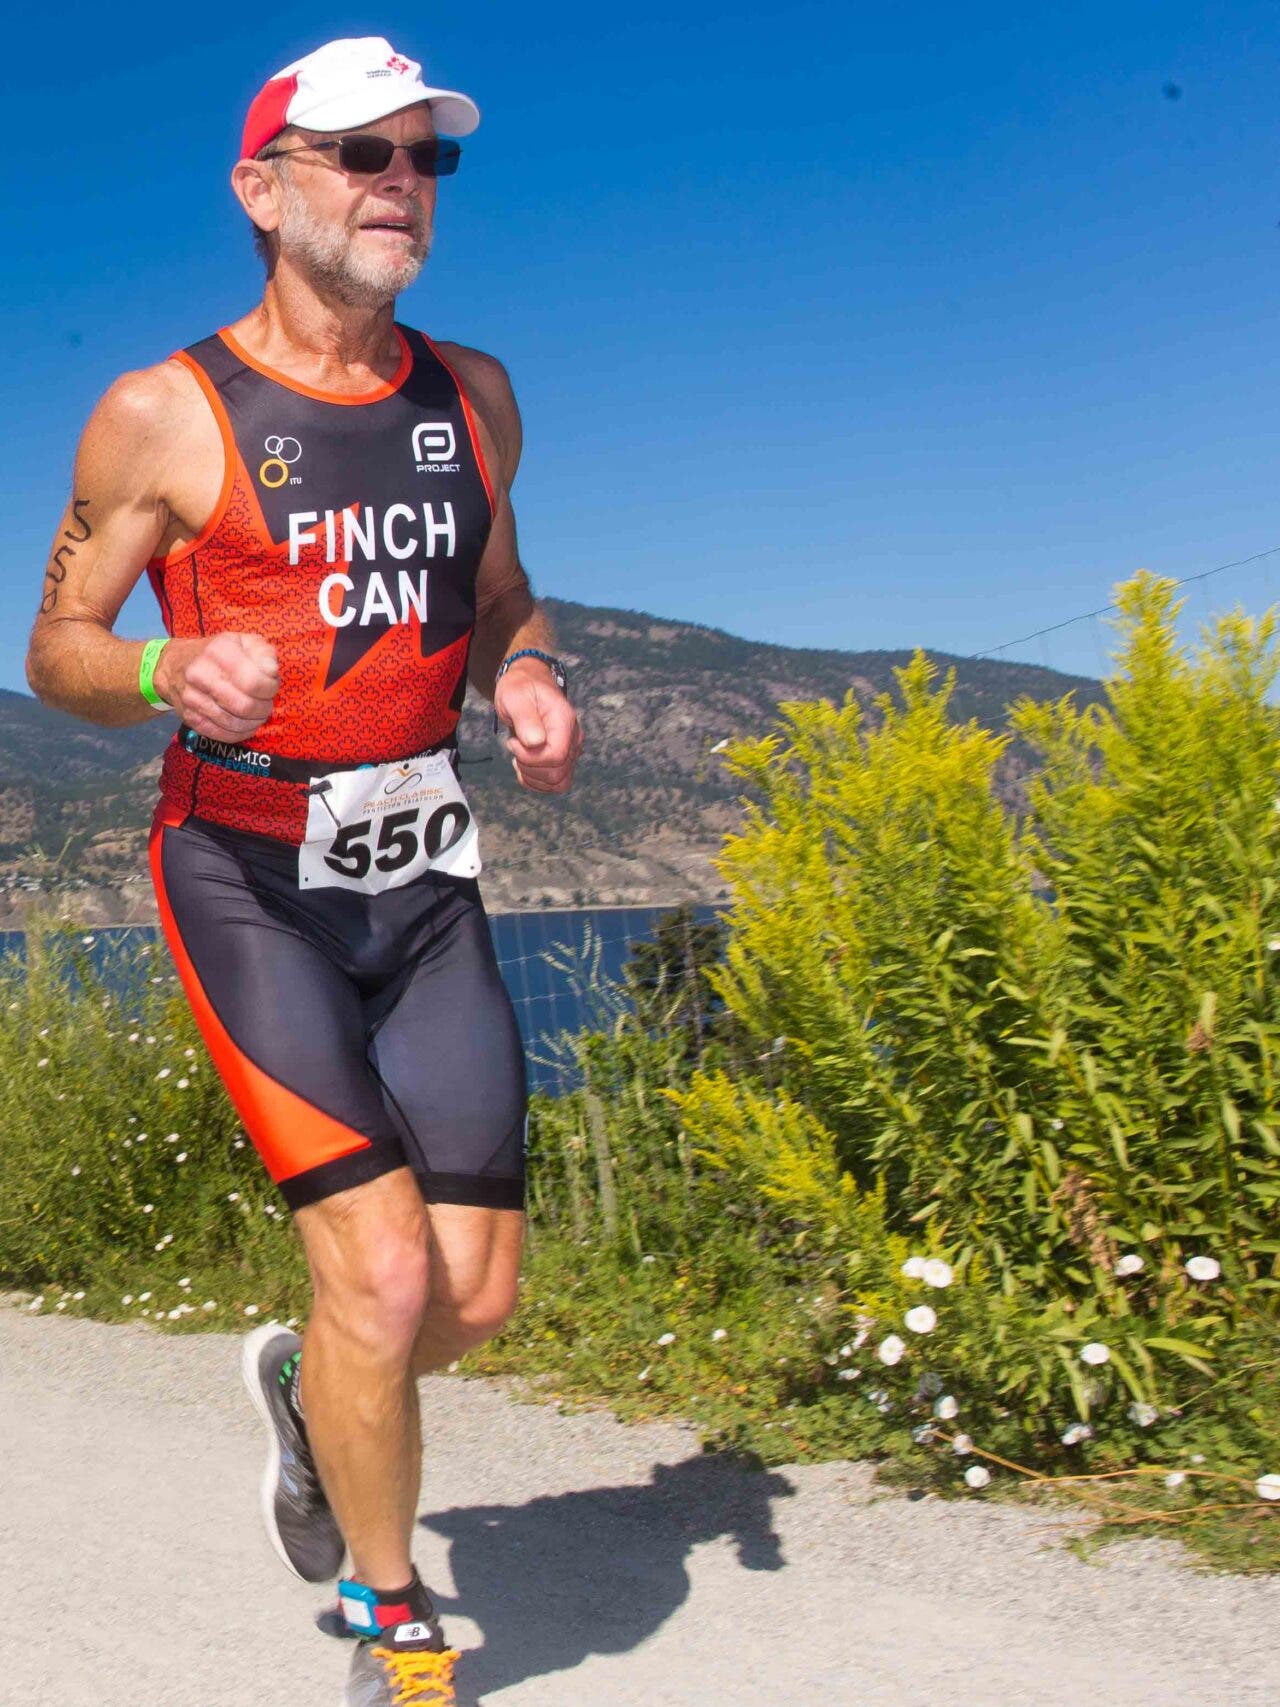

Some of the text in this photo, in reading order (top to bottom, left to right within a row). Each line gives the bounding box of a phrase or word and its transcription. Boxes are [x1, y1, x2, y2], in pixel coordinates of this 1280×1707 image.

[289, 477, 302, 486] ITU
[416, 463, 461, 473] PROJECT
[288, 501, 456, 566] FINCH
[318, 569, 428, 628] CAN
[200, 735, 271, 768] DYNAMIC
[224, 757, 271, 778] EVENTS
[323, 801, 471, 879] 550
